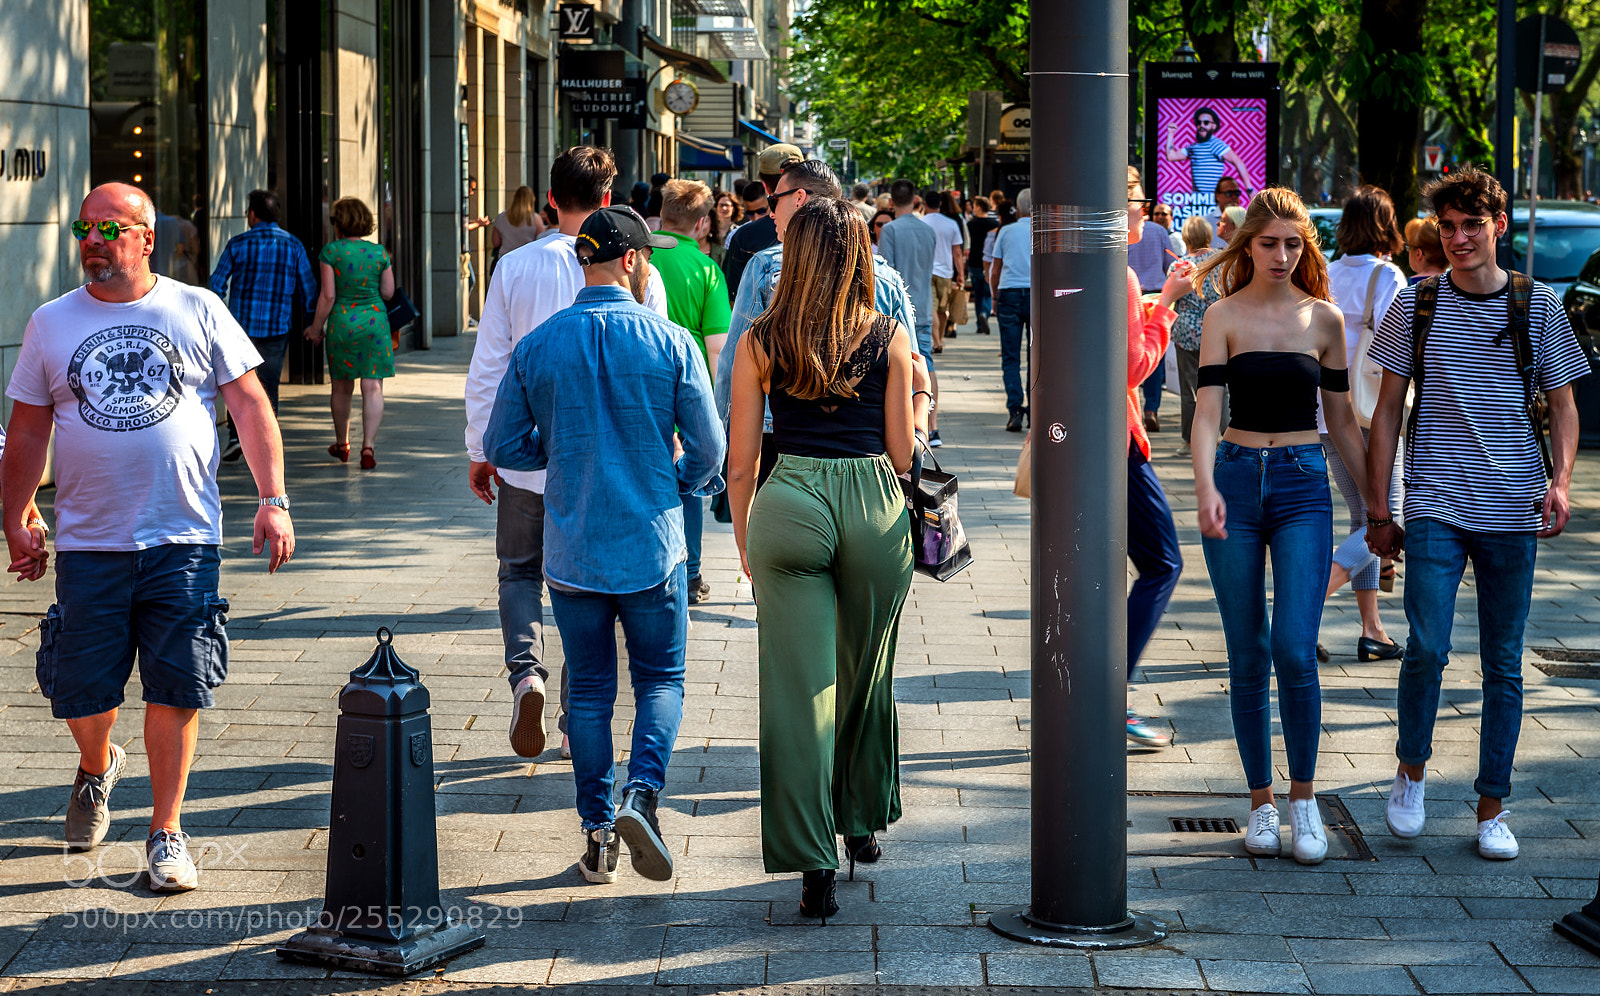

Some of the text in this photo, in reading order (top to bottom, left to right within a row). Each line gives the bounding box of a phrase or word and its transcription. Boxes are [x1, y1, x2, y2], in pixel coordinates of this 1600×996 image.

[1161, 71, 1193, 80] bluespot
[1231, 71, 1247, 79] Free
[561, 79, 622, 88] HALLHUBER
[571, 93, 632, 101] ALERIE
[76, 328, 170, 360] DENIM & SUPPLY CO.
[105, 340, 144, 354] D.S.R.L.
[85, 364, 166, 383] 19 67
[111, 395, 144, 405] SPEED
[104, 401, 151, 415] DEMONS
[117, 399, 175, 428] BROOKLYN
